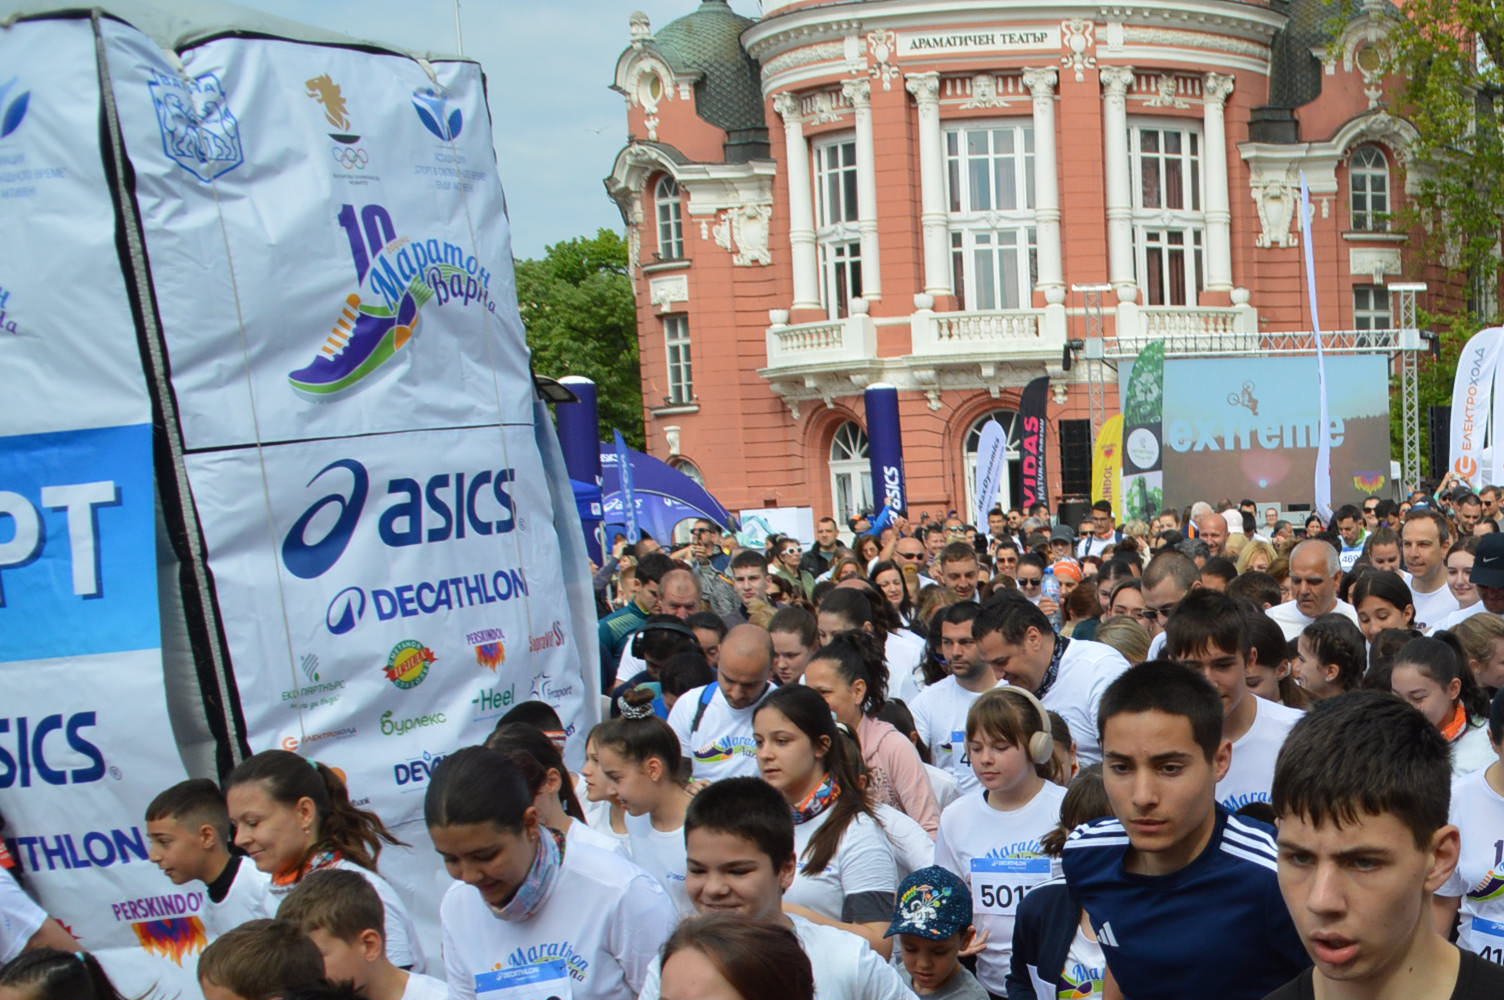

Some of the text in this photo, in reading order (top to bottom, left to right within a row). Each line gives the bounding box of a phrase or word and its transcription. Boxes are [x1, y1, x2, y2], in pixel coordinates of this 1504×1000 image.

[910, 31, 1048, 50] ДРАМАТИЧЕН ТЕАТЪР
[338, 203, 396, 289] 10
[370, 238, 491, 312] Маратон
[427, 266, 496, 313] Варна
[1462, 346, 1485, 451] ЕЛЕКТРОХОЛД
[378, 468, 516, 549] asics
[371, 567, 529, 622] DECATHLON
[508, 941, 589, 972] Marathon
